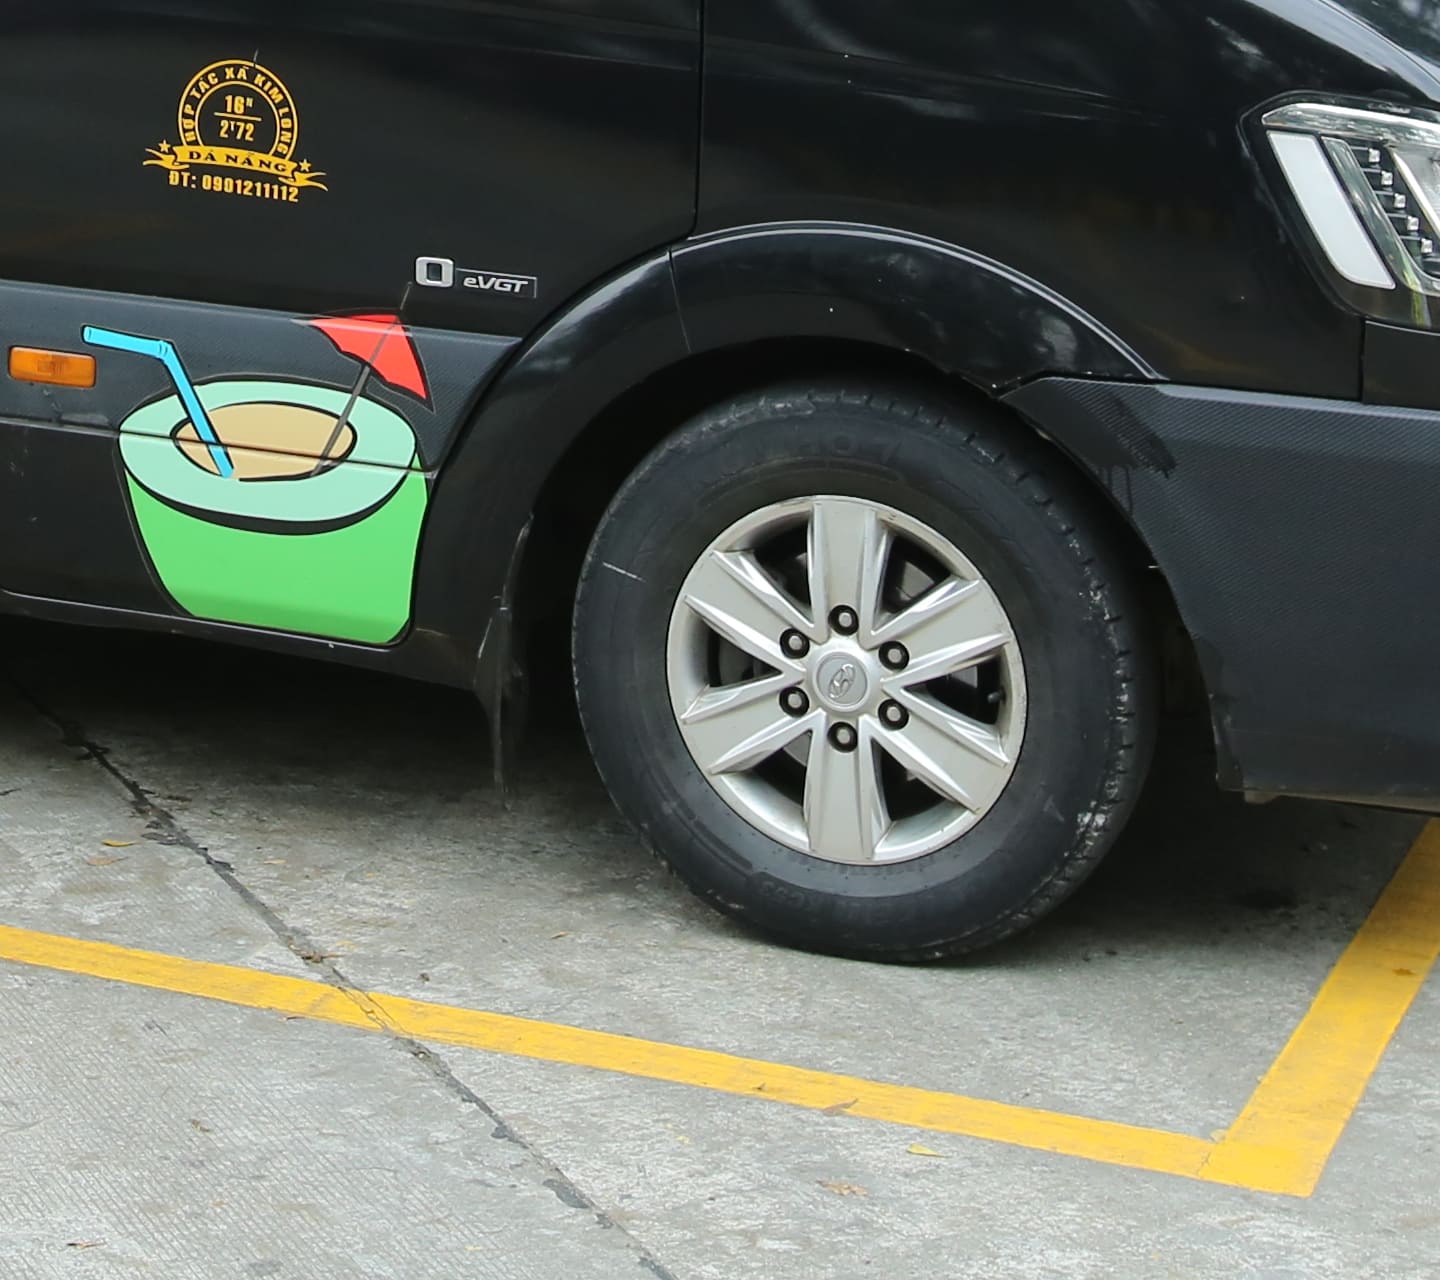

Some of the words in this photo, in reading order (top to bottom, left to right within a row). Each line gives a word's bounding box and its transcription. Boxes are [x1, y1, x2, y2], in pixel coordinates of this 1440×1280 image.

[254, 73, 284, 104] KIM
[277, 106, 292, 155] LONG
[202, 175, 298, 202] 0901211112
[463, 276, 529, 293] eVGT
